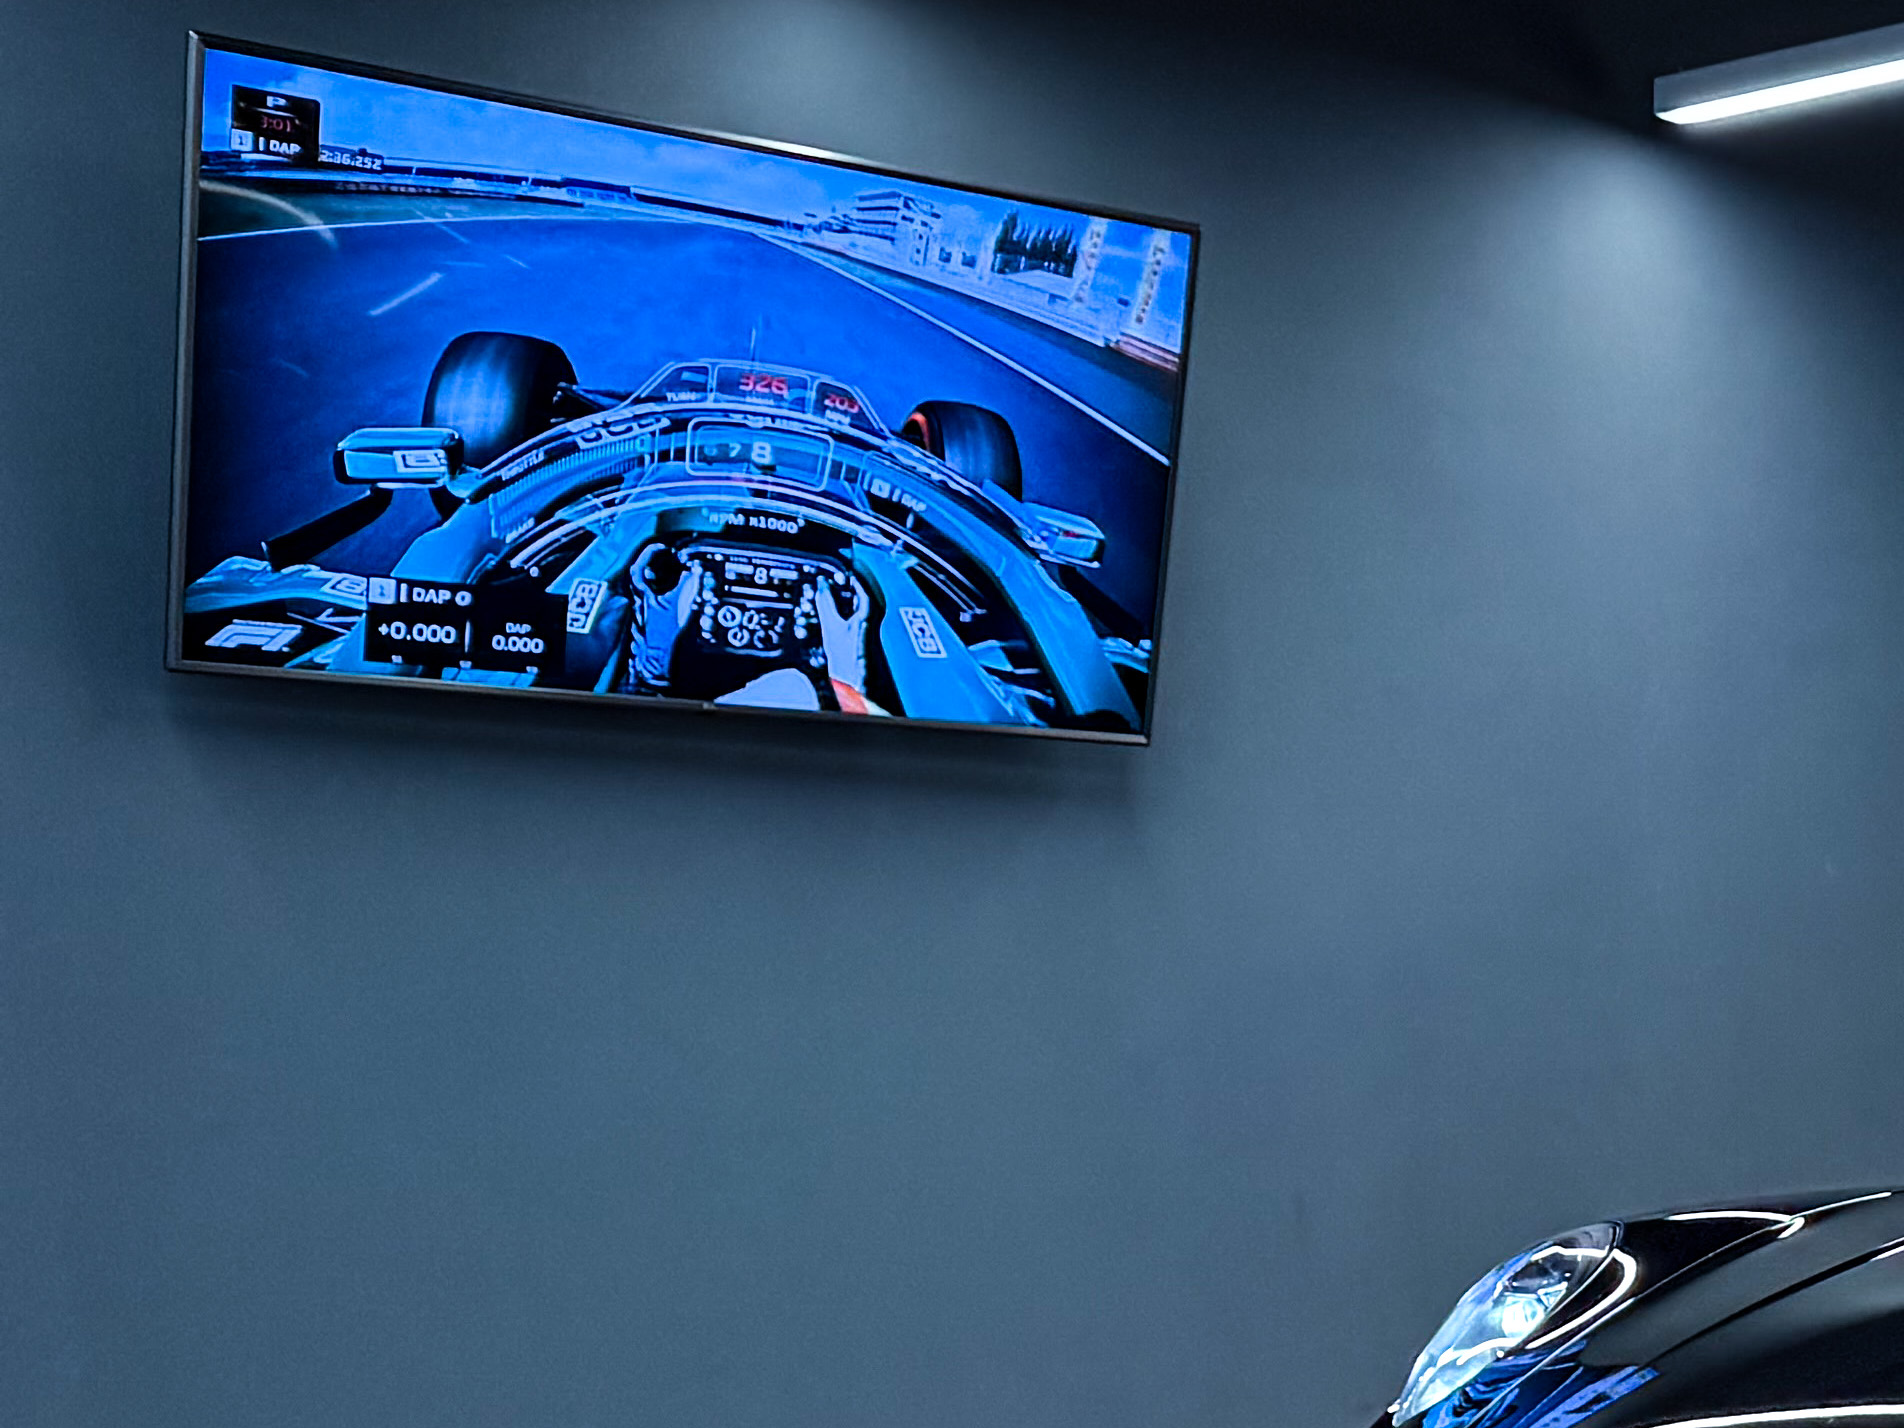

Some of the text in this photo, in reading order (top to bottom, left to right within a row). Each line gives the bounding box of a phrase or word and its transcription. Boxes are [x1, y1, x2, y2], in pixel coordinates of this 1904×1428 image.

[752, 441, 772, 465] 8
[412, 587, 451, 604] DAP
[378, 621, 457, 644] +0.000
[505, 622, 532, 634] DAP
[491, 634, 544, 654] 0.000
